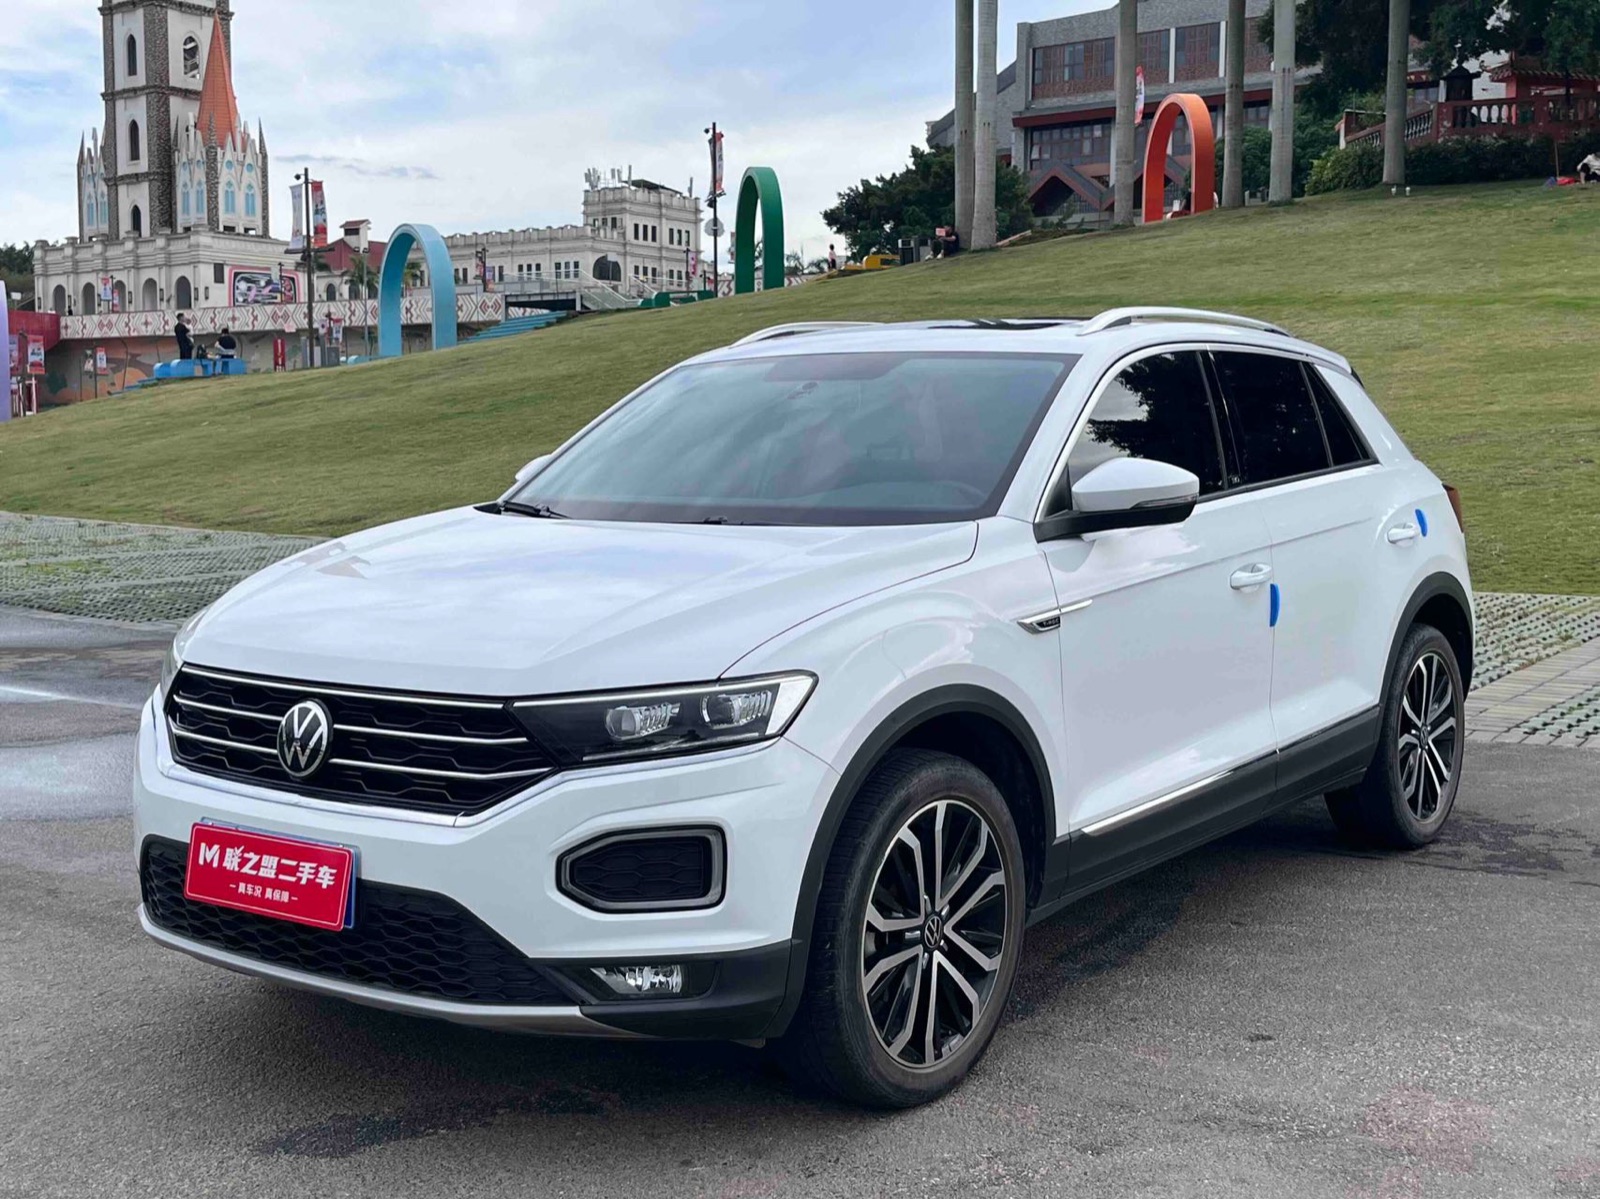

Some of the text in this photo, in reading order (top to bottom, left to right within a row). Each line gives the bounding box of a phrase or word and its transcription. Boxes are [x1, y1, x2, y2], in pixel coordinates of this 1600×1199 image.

[222, 845, 338, 889] 联之盟二手车
